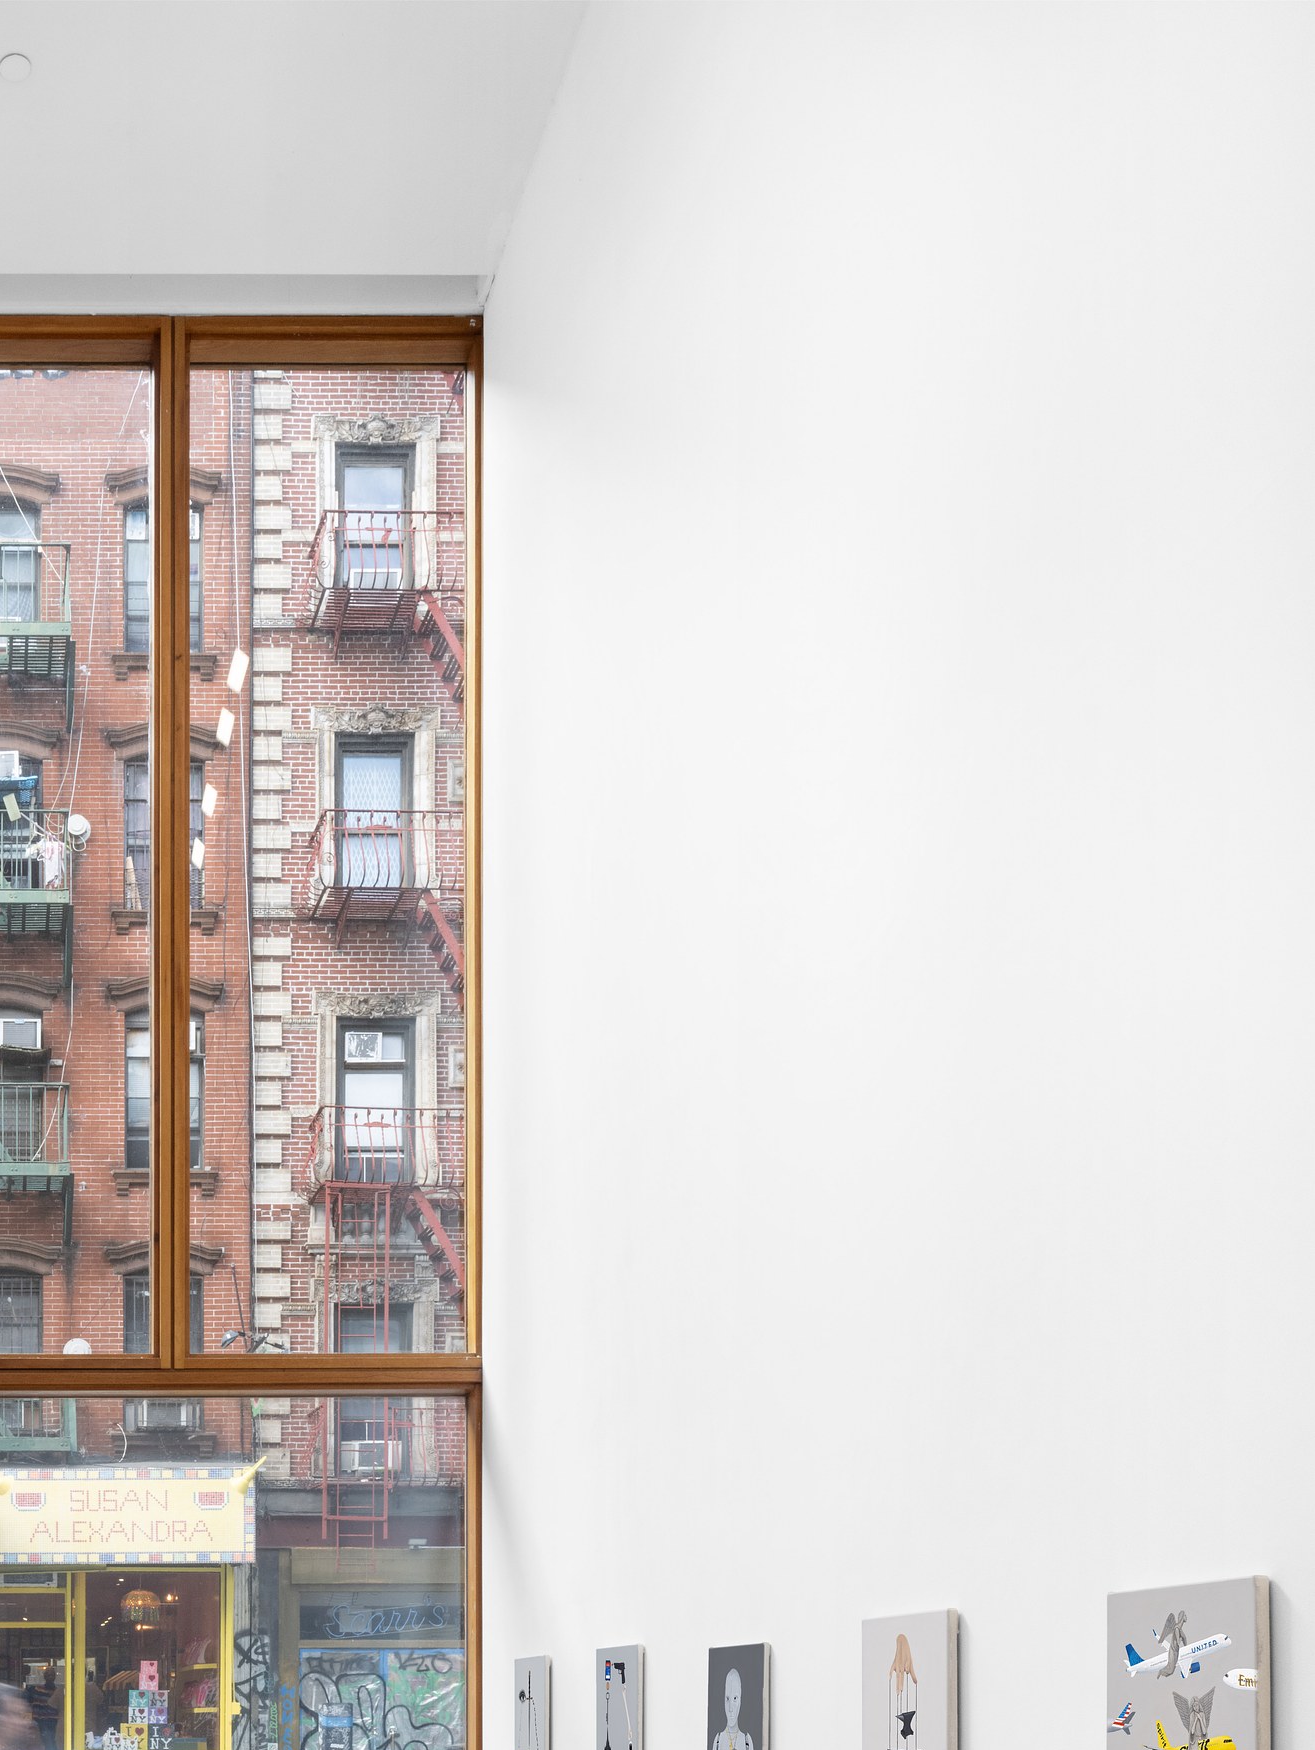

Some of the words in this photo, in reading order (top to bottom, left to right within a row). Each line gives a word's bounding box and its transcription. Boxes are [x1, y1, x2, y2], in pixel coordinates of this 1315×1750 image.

[69, 1489, 169, 1512] SUSAN
[30, 1520, 214, 1543] ALEXANDRA
[324, 1594, 448, 1638] Scarr's
[1191, 1639, 1218, 1654] UNITED
[150, 1738, 173, 1750] NY
